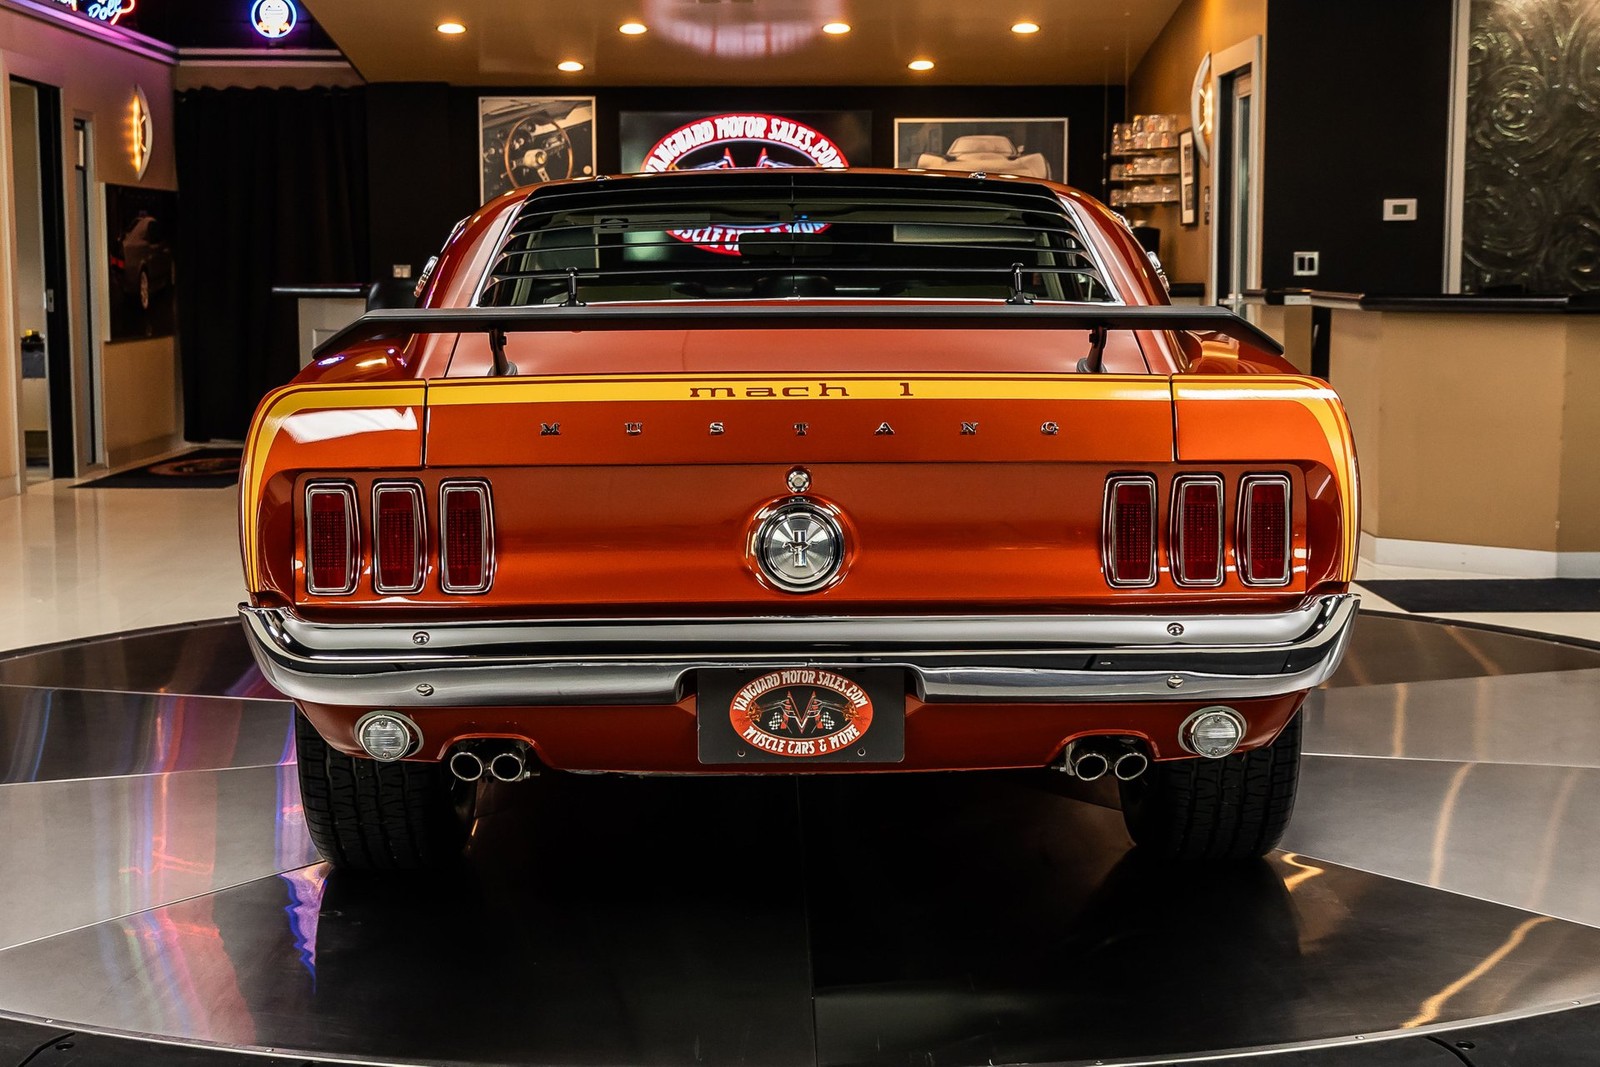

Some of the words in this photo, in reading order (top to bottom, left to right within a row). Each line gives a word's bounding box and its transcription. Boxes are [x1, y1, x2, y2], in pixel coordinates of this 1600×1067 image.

[714, 116, 768, 139] MOTOR
[690, 382, 850, 398] mach
[900, 382, 914, 396] 1
[733, 673, 780, 711] VANGUARD
[781, 670, 816, 685] MOTOR
[817, 671, 869, 708] SALES.COM
[743, 726, 786, 752] MUSCLE
[787, 740, 815, 755] CARS
[819, 739, 827, 753] &
[828, 724, 860, 749] MORE
